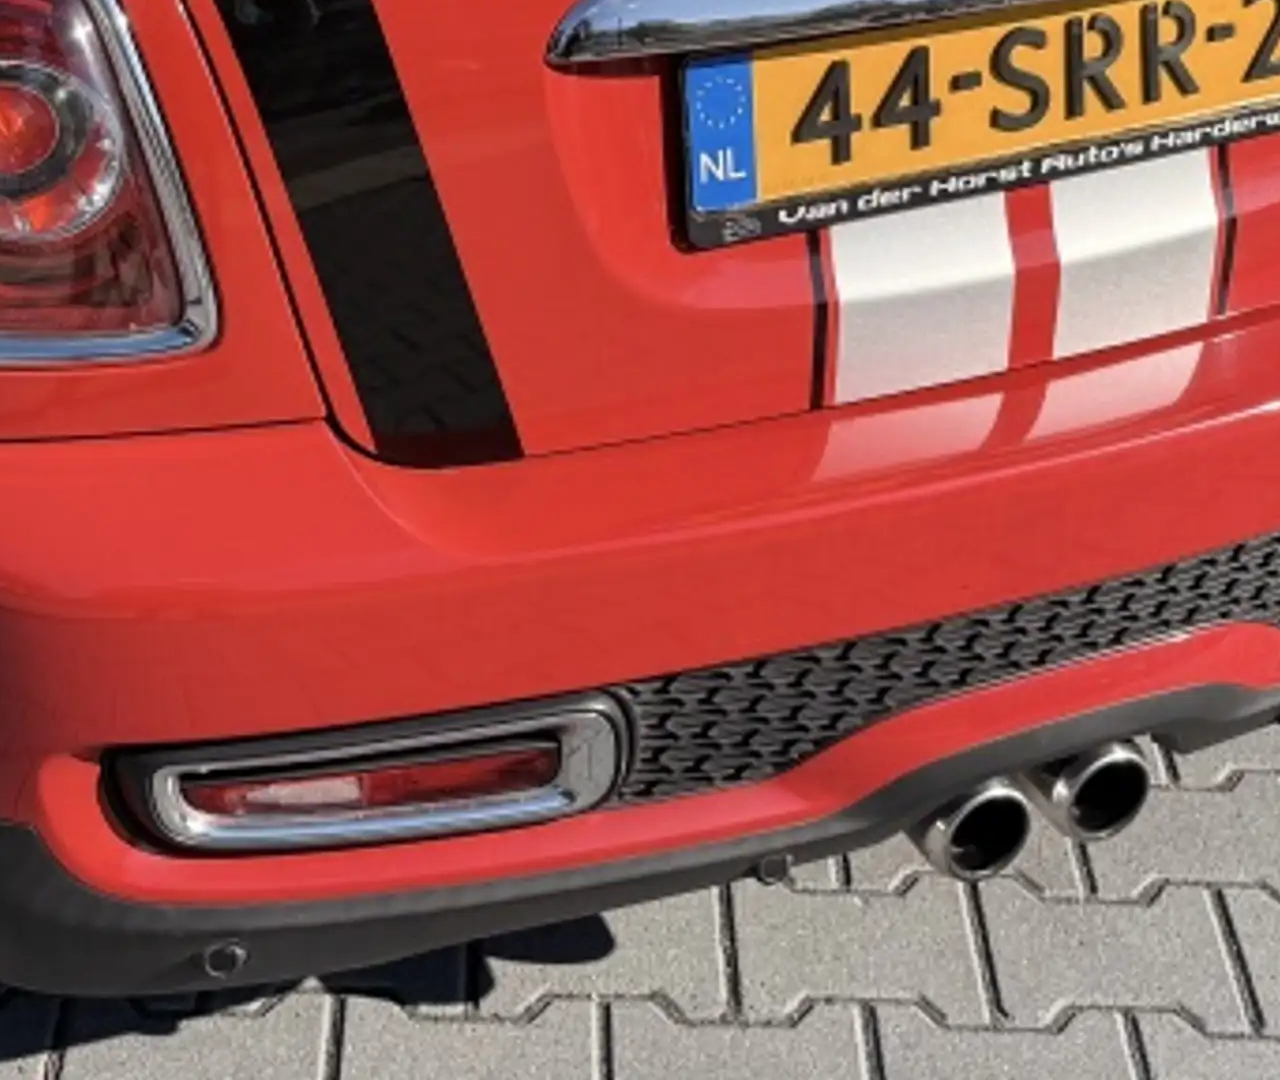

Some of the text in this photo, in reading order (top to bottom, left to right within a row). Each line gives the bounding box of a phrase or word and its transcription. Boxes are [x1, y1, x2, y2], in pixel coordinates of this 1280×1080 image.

[699, 146, 747, 185] NL
[777, 198, 850, 224] Van
[857, 187, 923, 212] der
[929, 160, 1033, 197] Horst
[1040, 142, 1145, 174] Auto's
